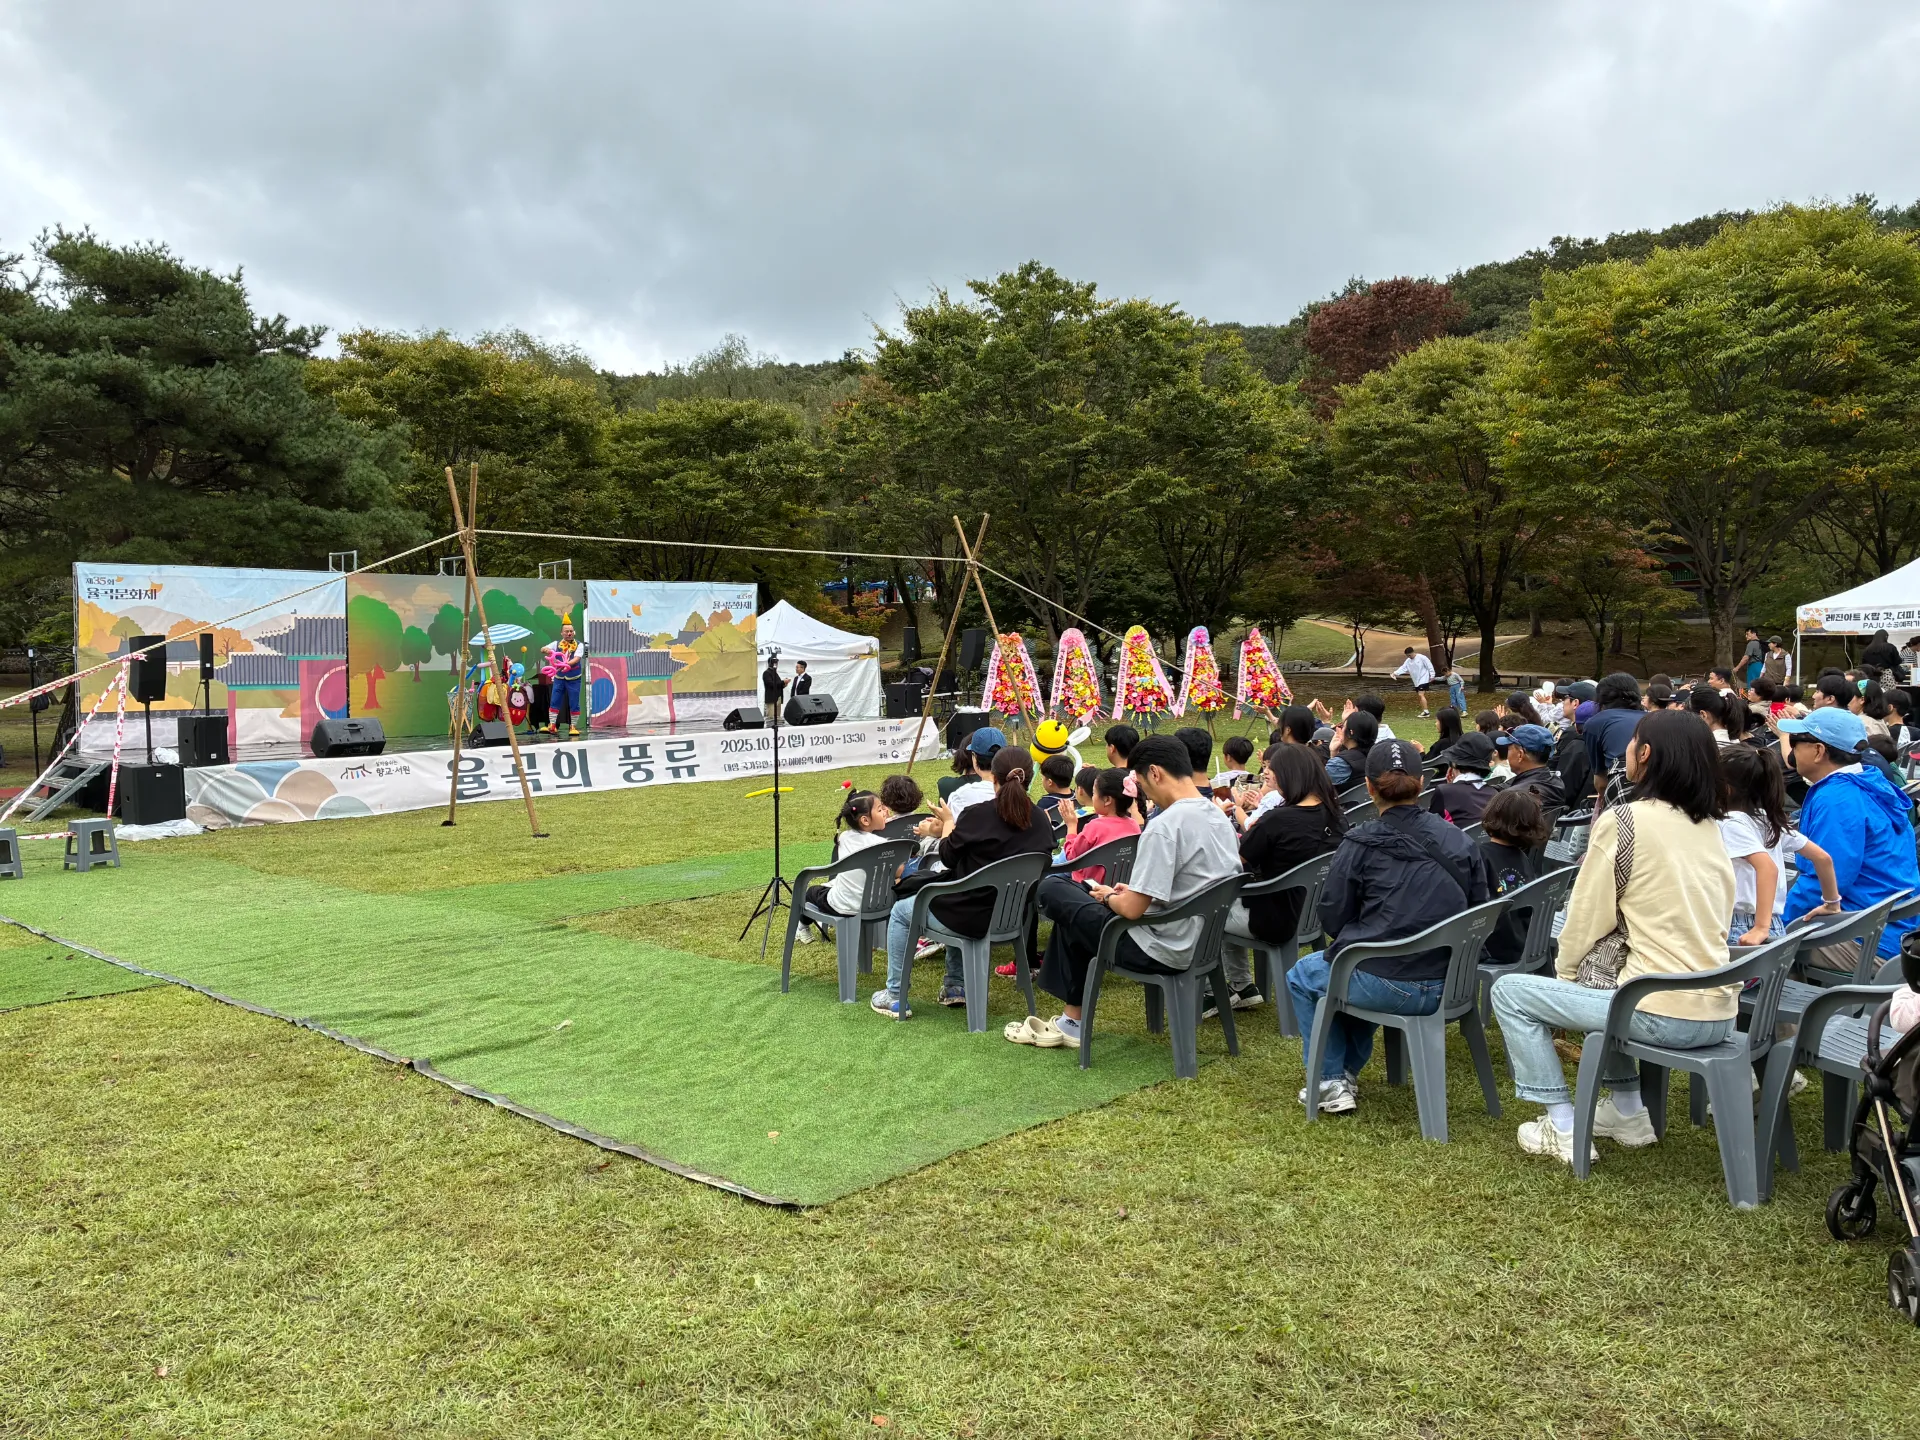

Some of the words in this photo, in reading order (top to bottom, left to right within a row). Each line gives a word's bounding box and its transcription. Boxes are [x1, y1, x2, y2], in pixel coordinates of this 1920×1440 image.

[86, 587, 157, 600] 율곡문화제
[1825, 612, 1861, 622] 레진아트
[1896, 610, 1915, 620] 더피
[1862, 621, 1884, 629] PAJU
[445, 747, 593, 801] 율곡의
[617, 739, 701, 784] 풍류
